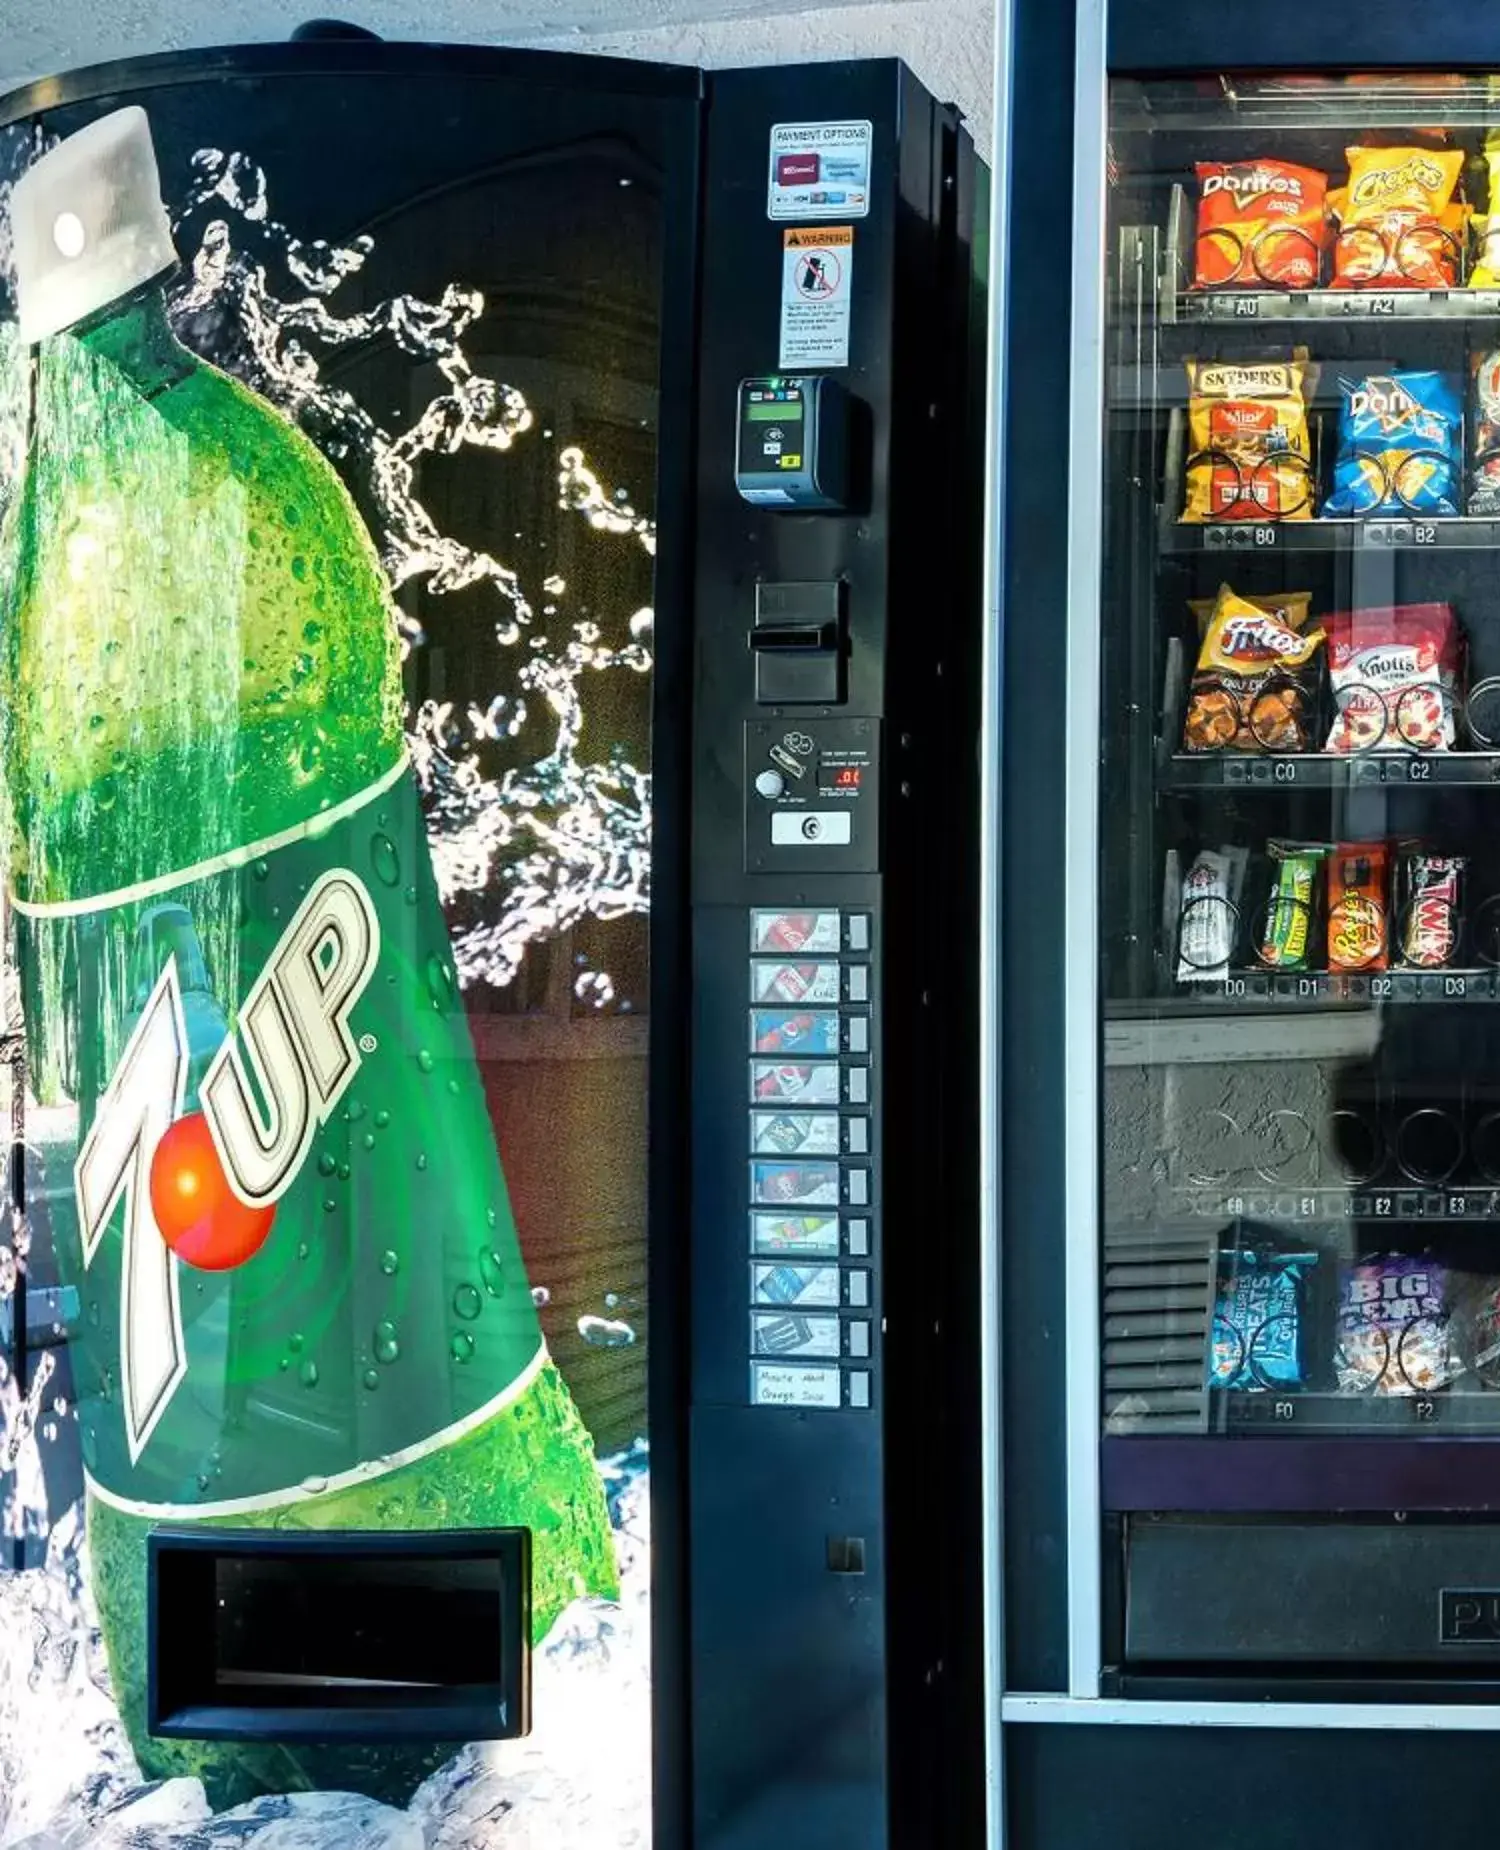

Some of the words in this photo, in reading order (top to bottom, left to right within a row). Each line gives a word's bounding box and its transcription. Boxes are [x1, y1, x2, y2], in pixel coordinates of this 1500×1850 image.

[777, 130, 820, 141] PAYMENT
[823, 127, 867, 140] OPTIONS
[1202, 172, 1302, 197] Doritos
[1352, 158, 1444, 206] Cheetos
[801, 233, 851, 244] WARNING
[1373, 300, 1393, 313] A2
[1204, 367, 1283, 387] SNYDER'S
[1415, 526, 1436, 544] B2
[1409, 762, 1431, 780] C2
[1225, 978, 1245, 996] D0
[1300, 978, 1318, 996] D1
[1371, 979, 1392, 995] D2
[1445, 979, 1466, 995] D3
[1301, 1198, 1316, 1215] E1
[1375, 1198, 1392, 1215] E2
[1450, 1197, 1466, 1214] E3
[1349, 1272, 1430, 1303] BIG
[1339, 1297, 1442, 1320] TEXAS
[1275, 1402, 1293, 1419] F0
[1416, 1402, 1434, 1420] F2
